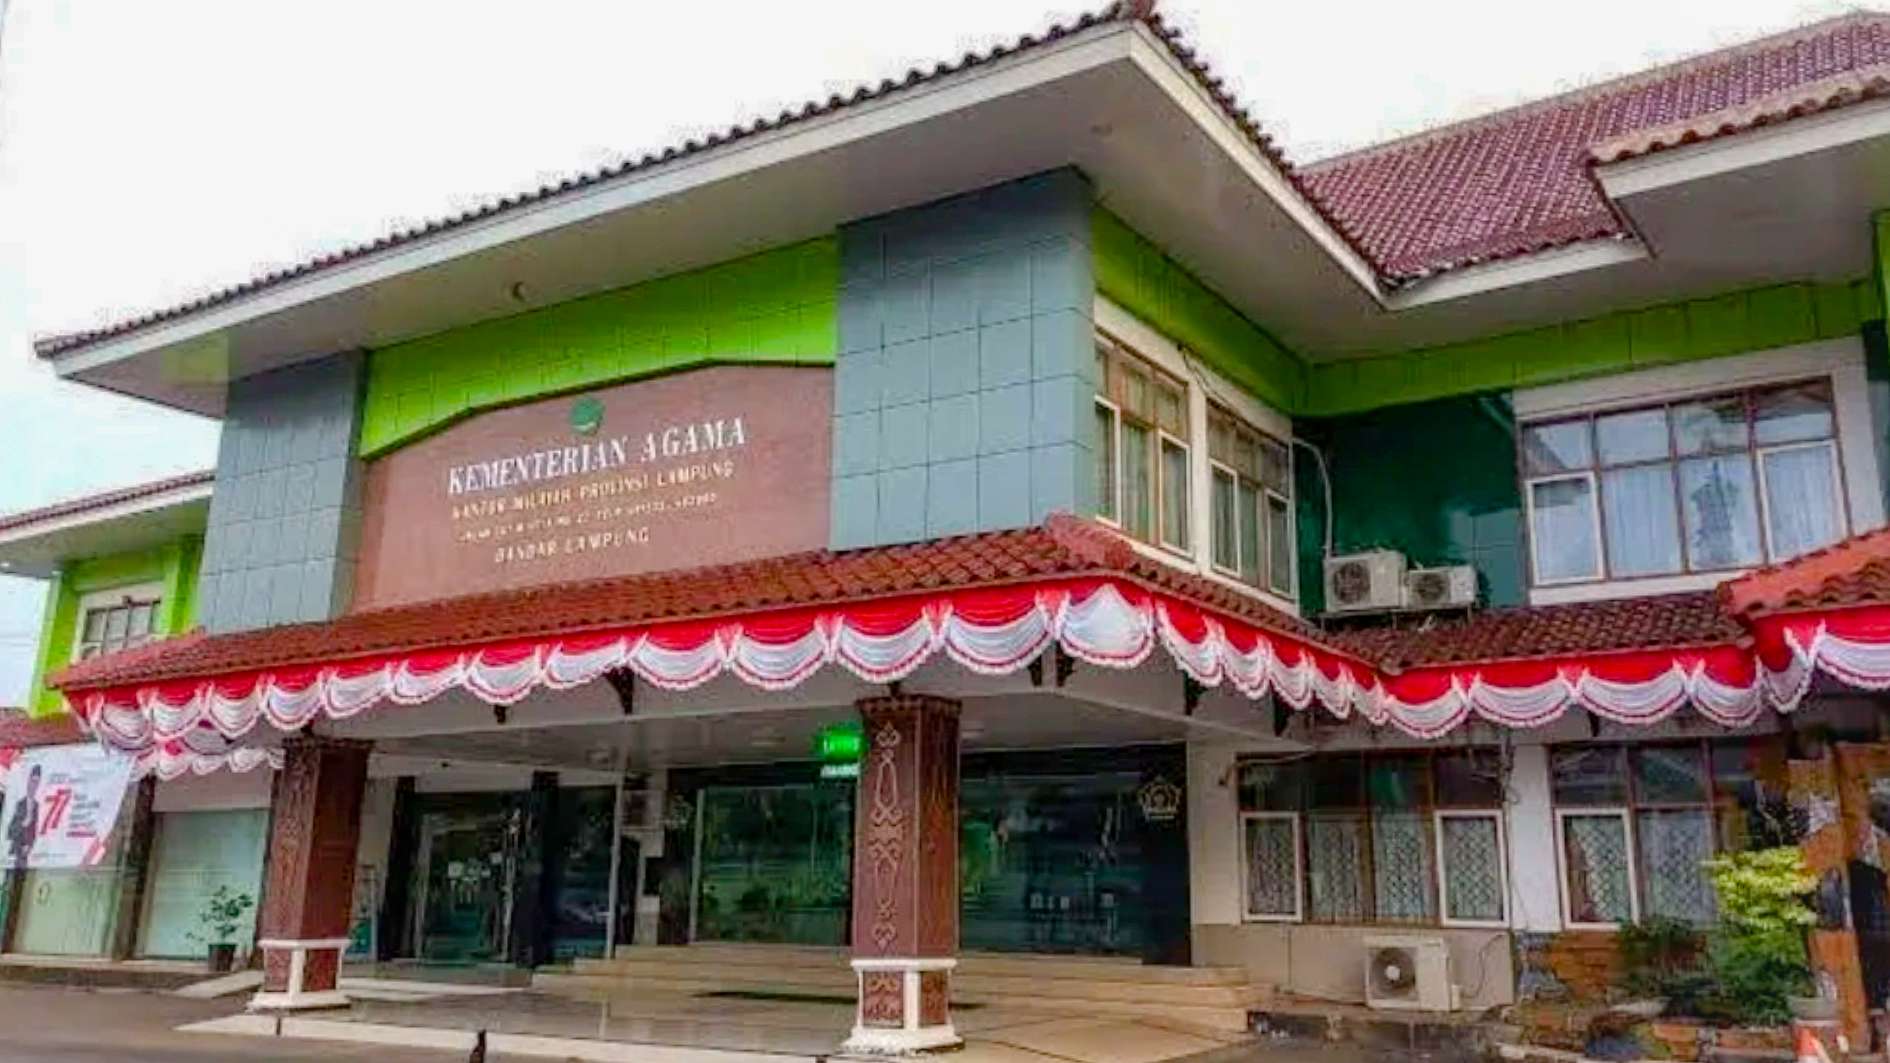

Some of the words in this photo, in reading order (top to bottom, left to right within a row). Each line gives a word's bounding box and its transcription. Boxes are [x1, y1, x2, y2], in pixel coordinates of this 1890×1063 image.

[448, 435, 628, 494] KEMENTERIAN
[640, 416, 746, 462] AGAMA
[656, 459, 734, 488] LAMPUNG
[40, 788, 72, 835] 77
